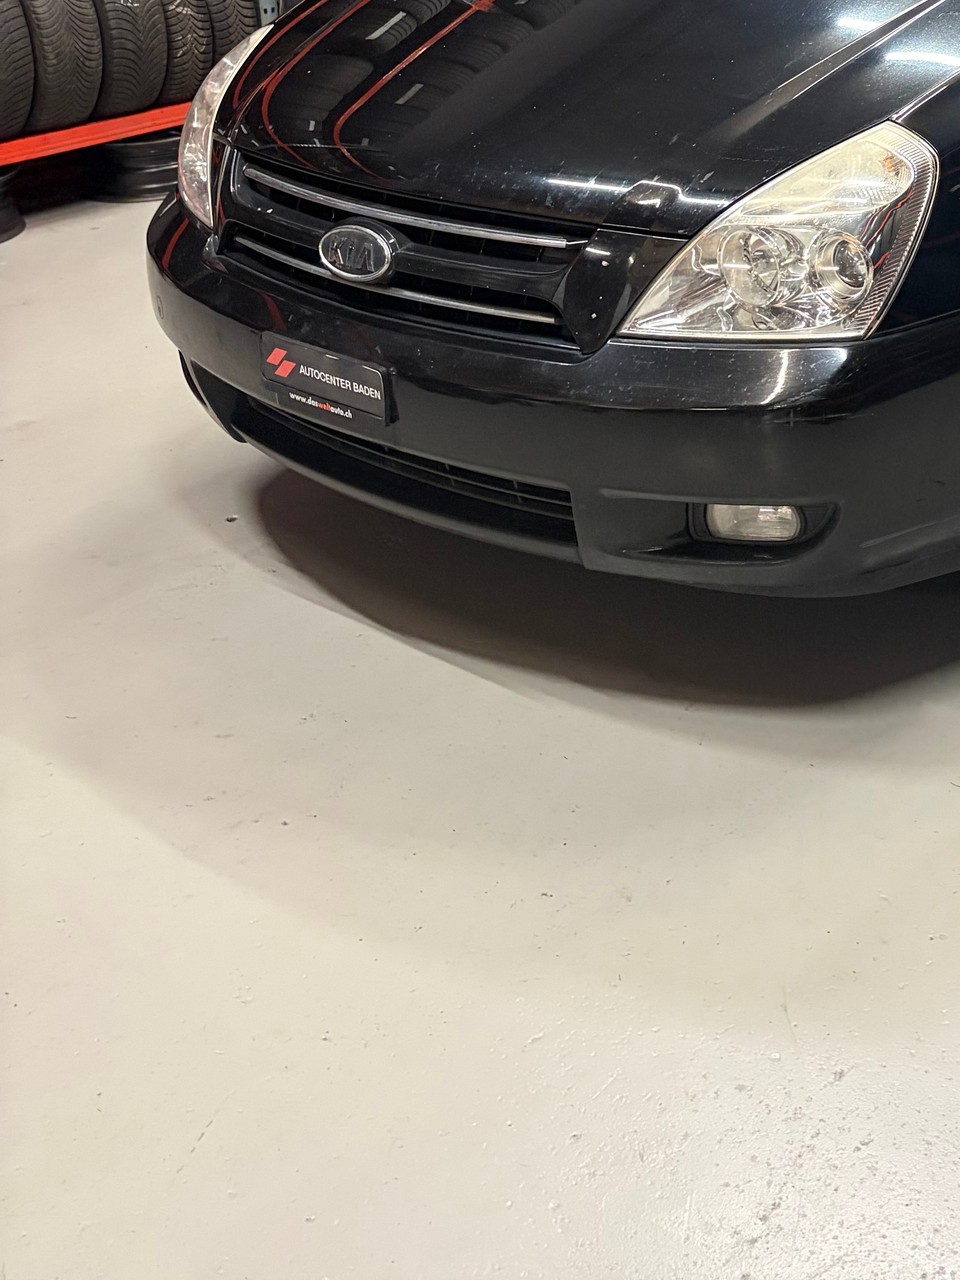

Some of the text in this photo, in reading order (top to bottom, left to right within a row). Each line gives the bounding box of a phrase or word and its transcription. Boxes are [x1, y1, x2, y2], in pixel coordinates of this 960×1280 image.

[327, 234, 375, 273] KIA
[299, 364, 381, 401] AUTOCENTER BADEN
[289, 391, 353, 419] www.dasweltauto.ch
